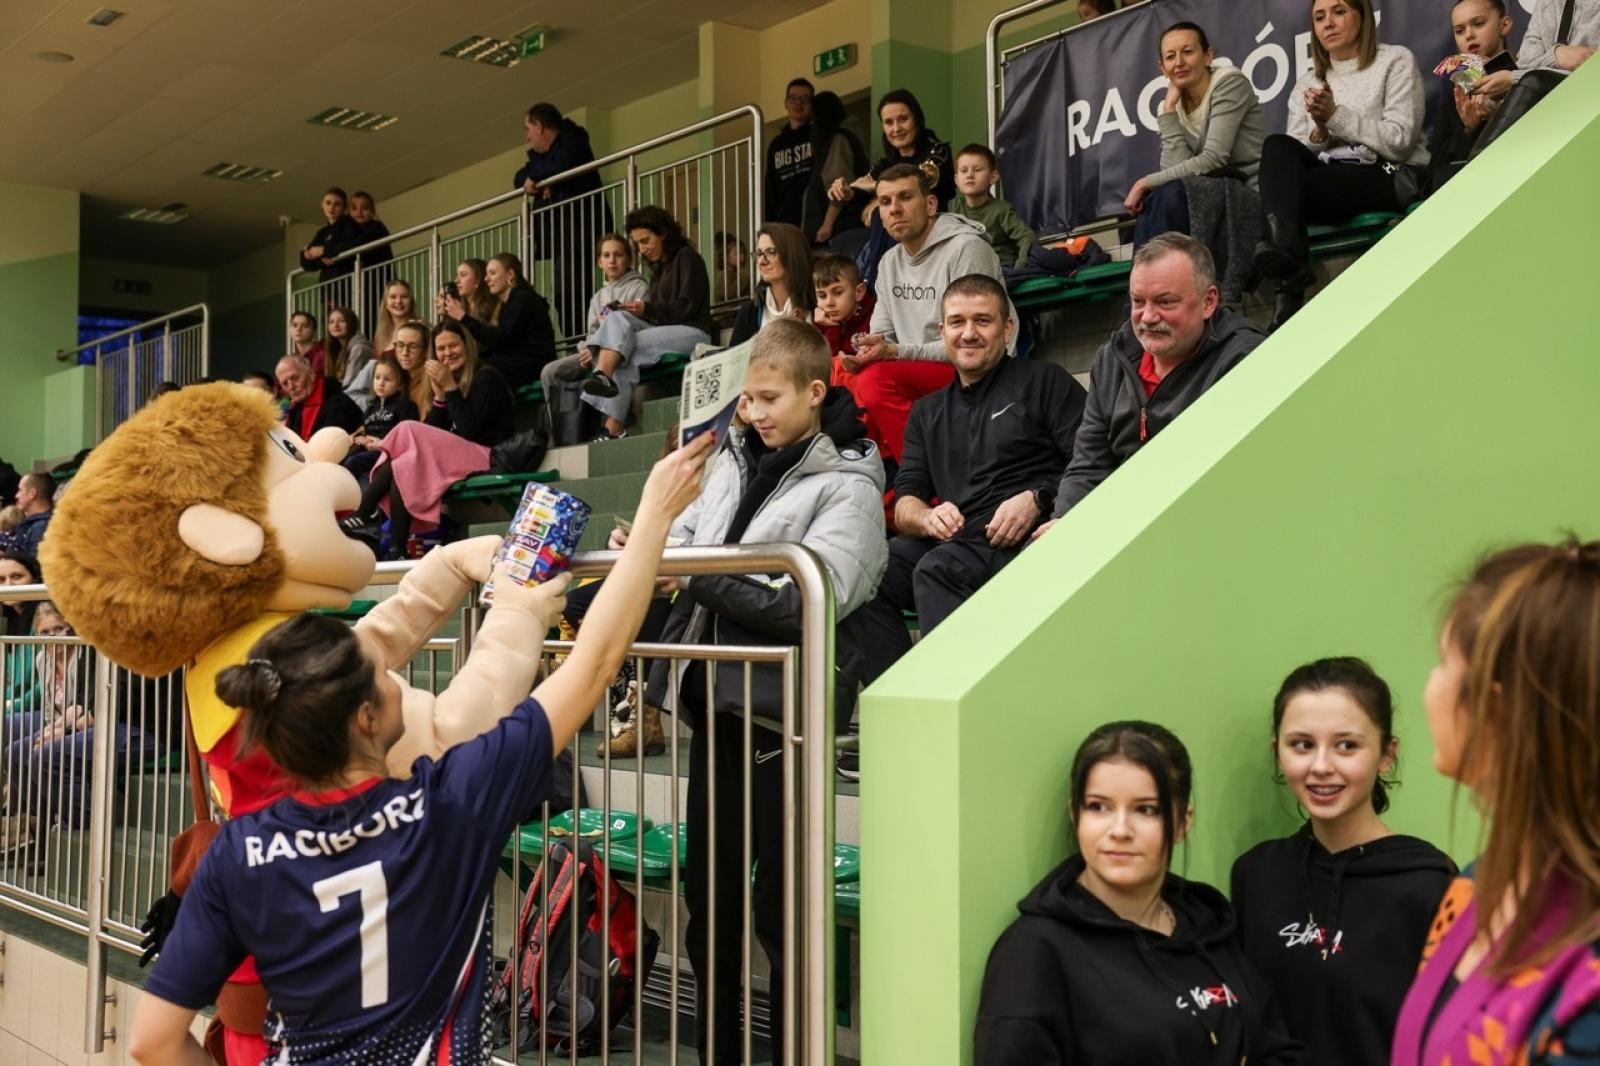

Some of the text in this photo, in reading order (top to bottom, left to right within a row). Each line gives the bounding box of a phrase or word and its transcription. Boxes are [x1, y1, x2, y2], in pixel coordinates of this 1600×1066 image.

[774, 141, 813, 170] BIG STA
[312, 860, 389, 1009] 7
